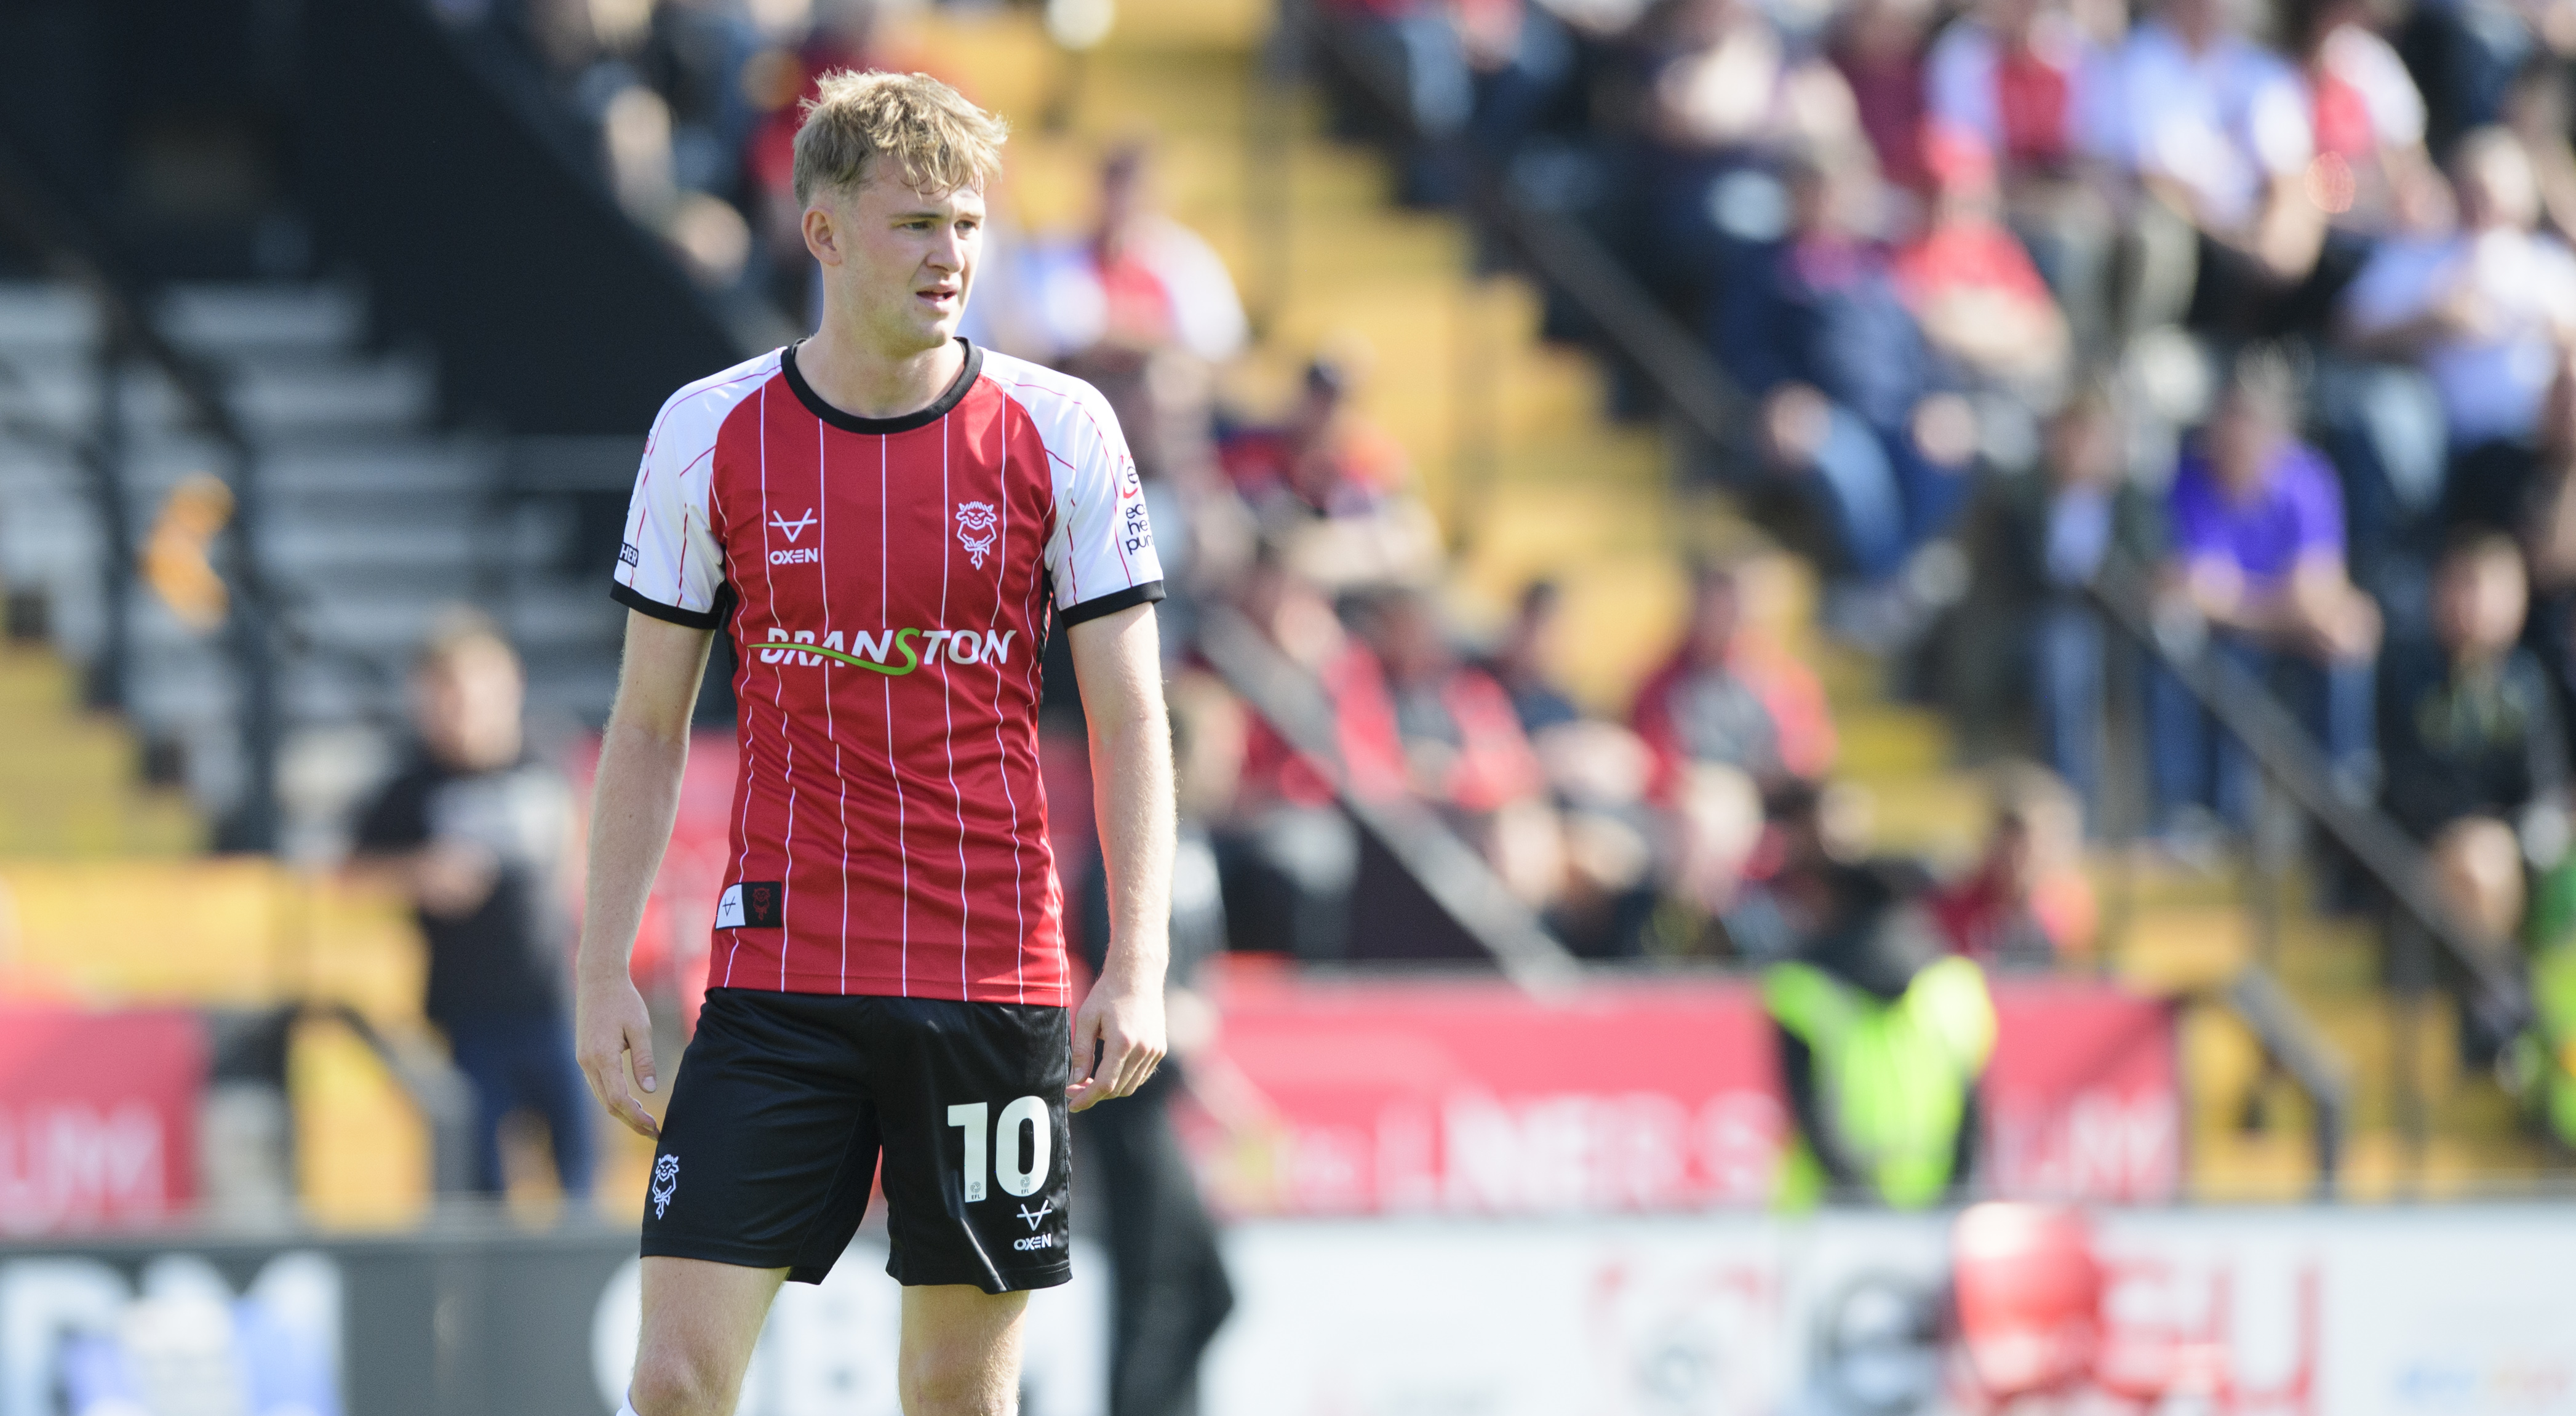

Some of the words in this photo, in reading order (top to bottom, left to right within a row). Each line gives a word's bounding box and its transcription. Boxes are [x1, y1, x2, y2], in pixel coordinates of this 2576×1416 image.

[769, 547, 818, 566] OXEN
[754, 627, 1017, 676] BRANSTON
[947, 1095, 1051, 1202] 10
[1014, 1233, 1051, 1250] OXEN
